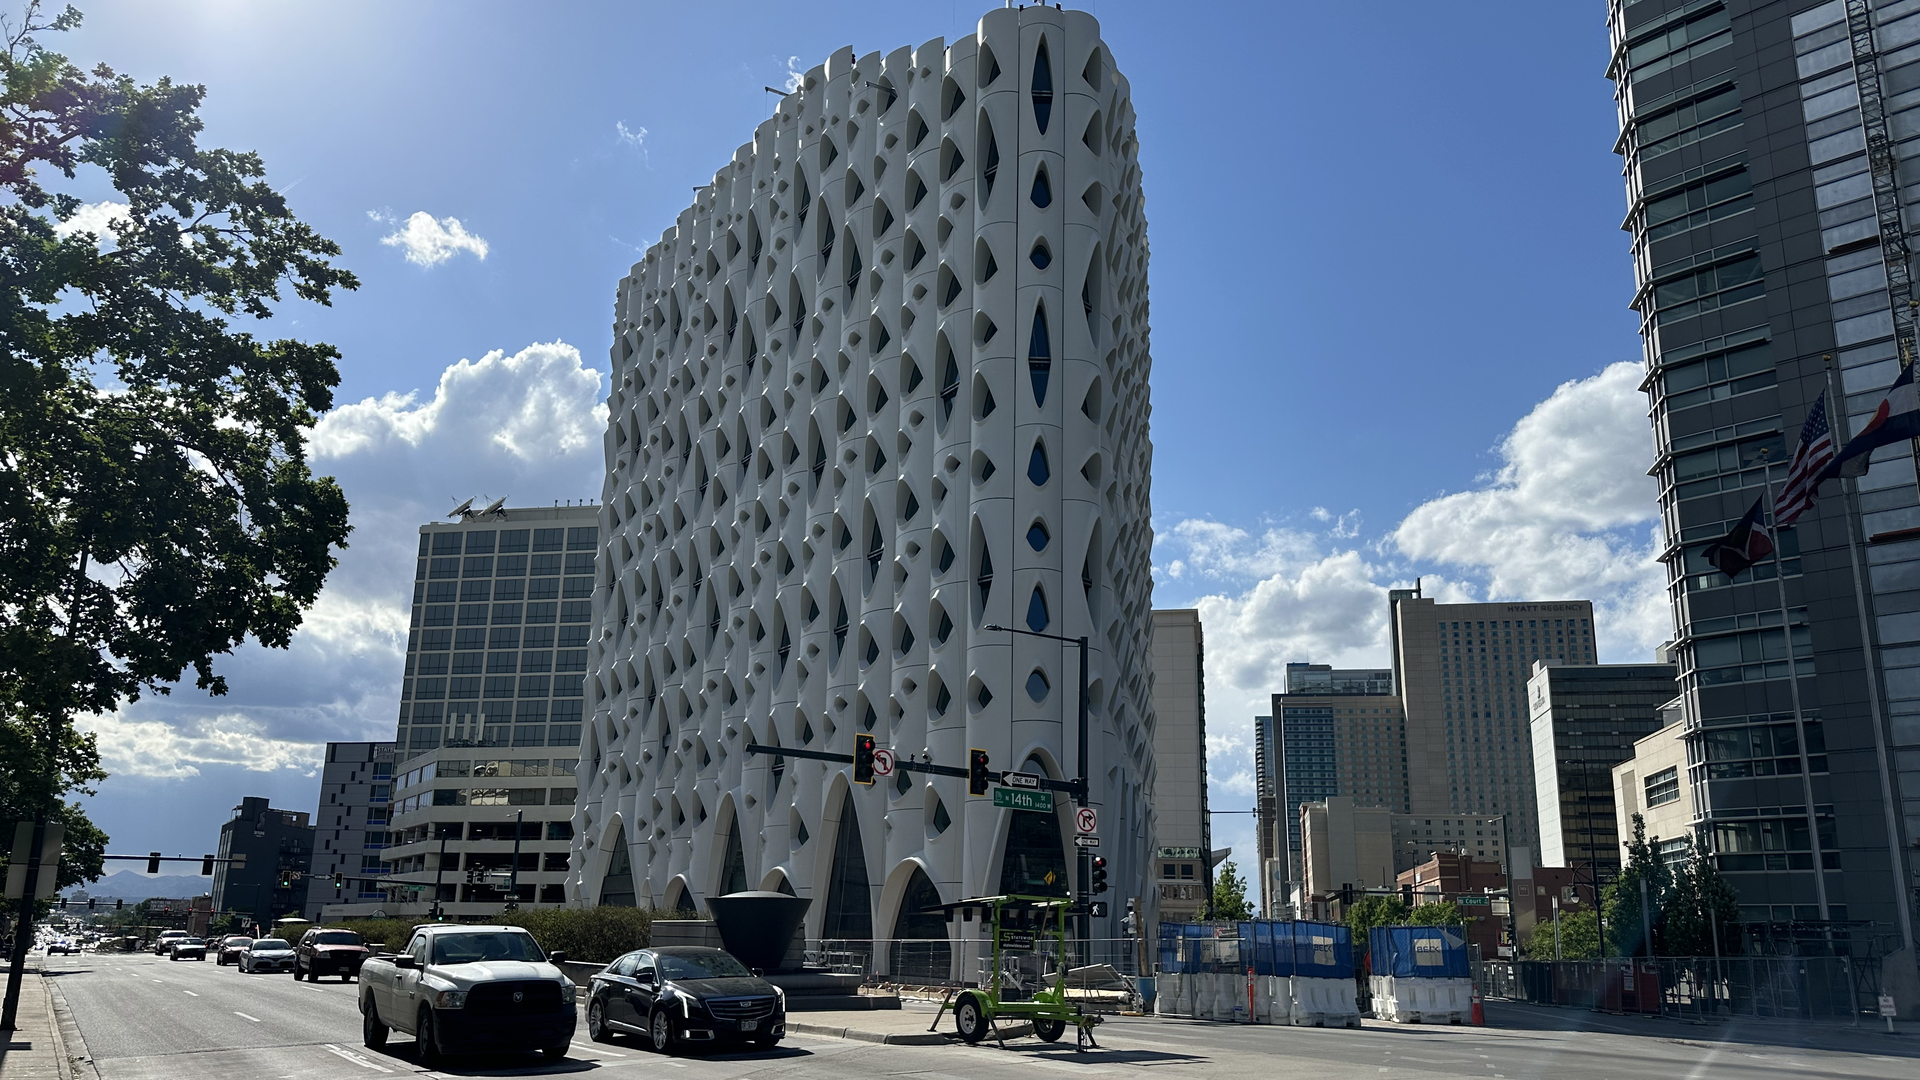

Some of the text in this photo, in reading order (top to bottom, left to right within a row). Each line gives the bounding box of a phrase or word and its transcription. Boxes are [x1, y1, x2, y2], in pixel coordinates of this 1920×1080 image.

[1541, 604, 1584, 612] REGENCY
[1012, 776, 1023, 784] ONE
[1011, 793, 1033, 807] 14th
[1314, 944, 1332, 952] BECK
